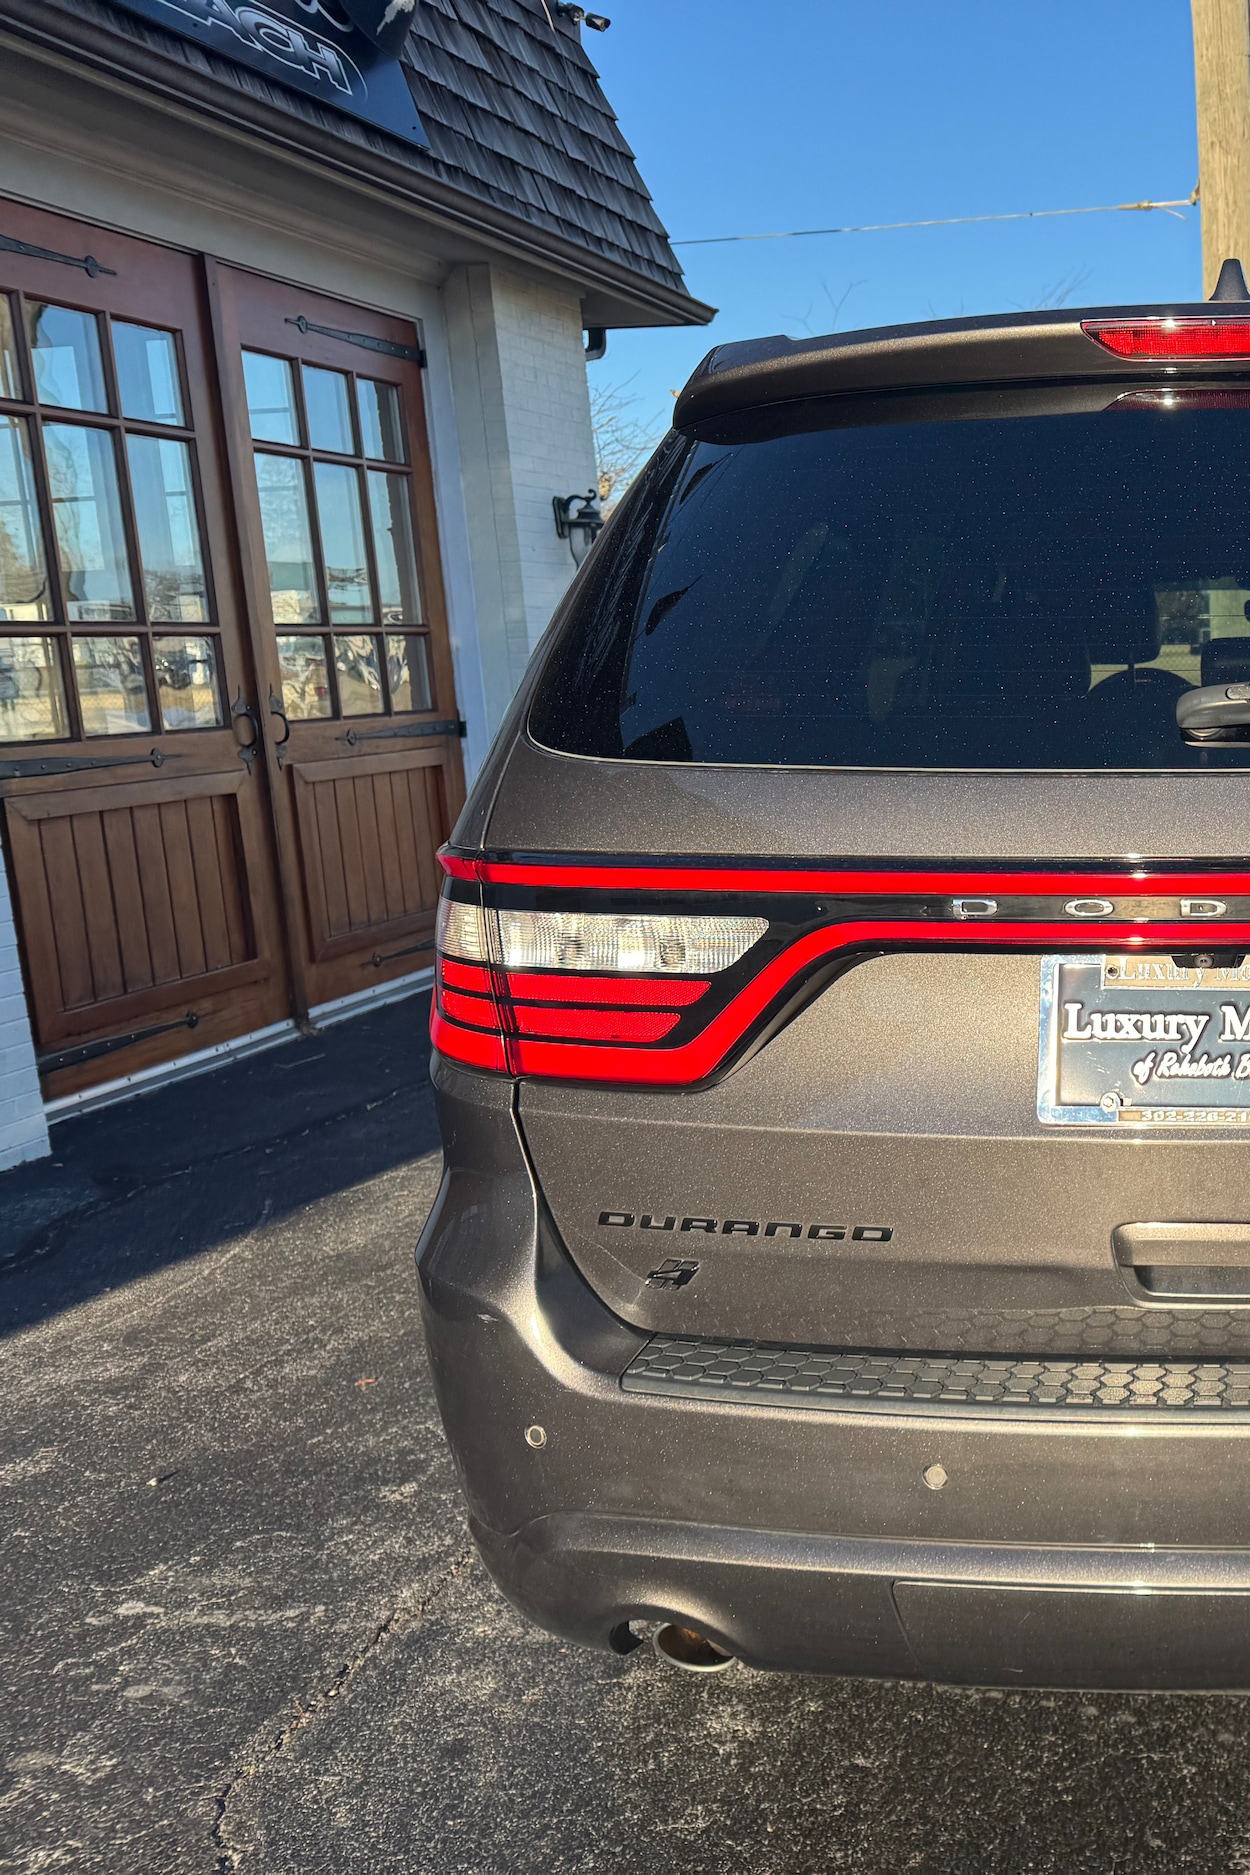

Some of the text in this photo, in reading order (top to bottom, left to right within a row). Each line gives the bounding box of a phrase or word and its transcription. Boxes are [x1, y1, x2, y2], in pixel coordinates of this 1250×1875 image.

[158, 0, 353, 96] ACH
[1062, 1002, 1210, 1053] Luxury
[1132, 1052, 1156, 1084] of
[599, 1211, 894, 1242] DURANGO
